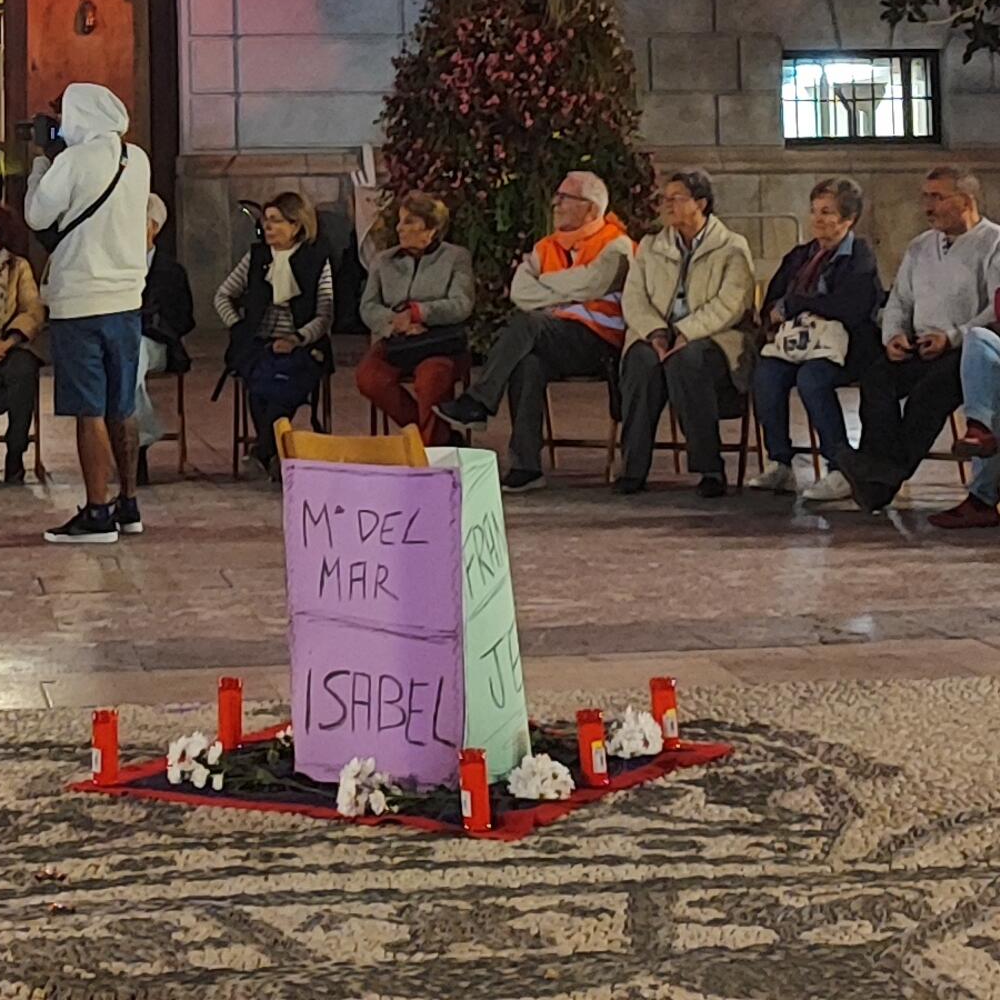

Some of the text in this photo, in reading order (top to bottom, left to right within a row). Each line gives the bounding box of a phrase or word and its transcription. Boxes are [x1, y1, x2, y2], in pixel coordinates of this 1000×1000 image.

[357, 507, 430, 546] DEL
[318, 555, 400, 601] MAR
[304, 667, 457, 749] ISABEL
